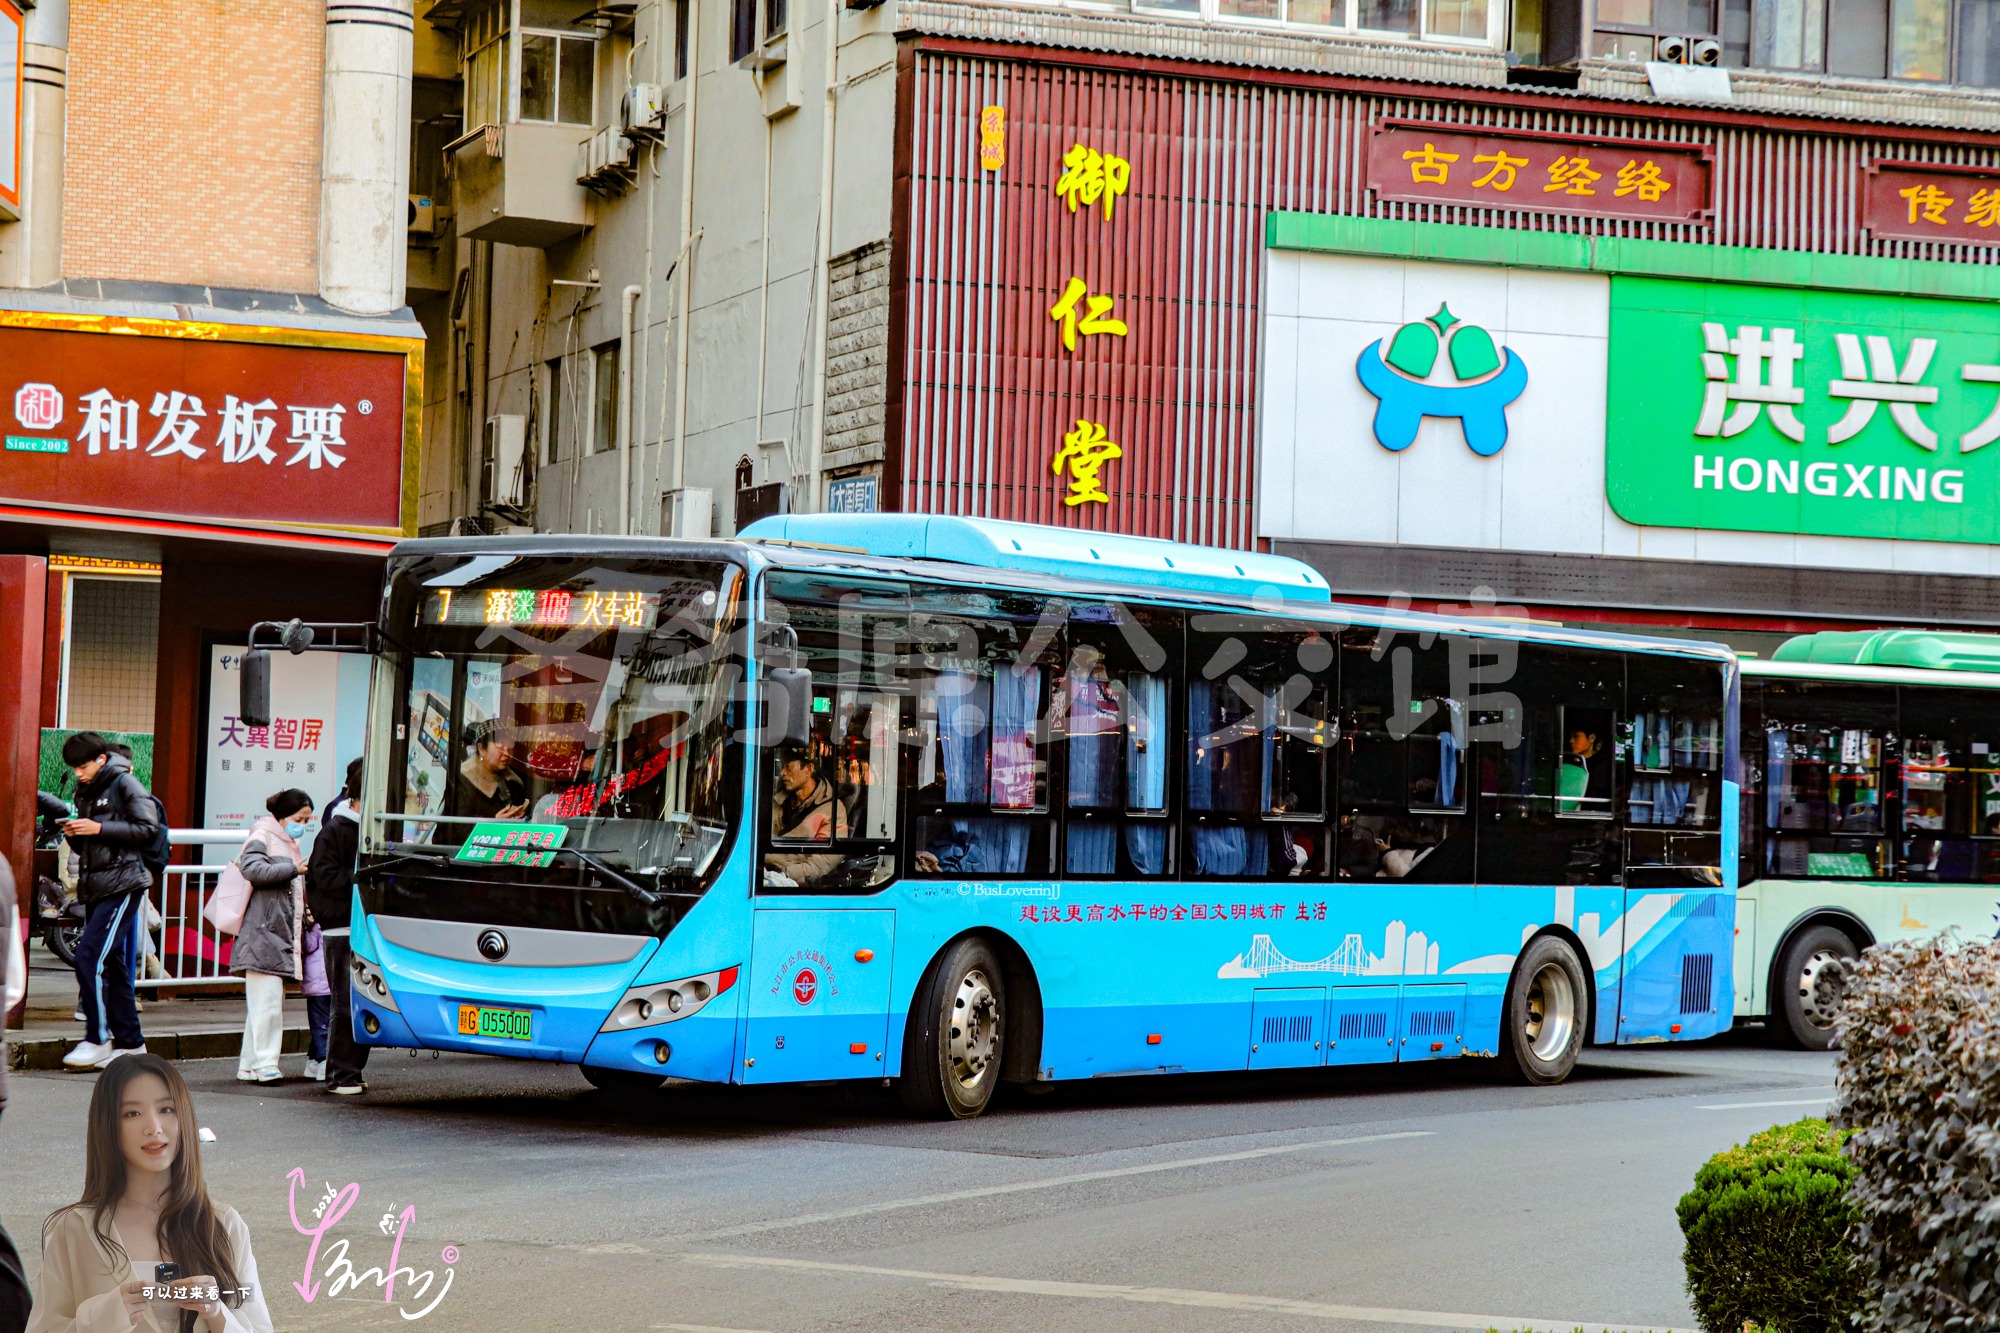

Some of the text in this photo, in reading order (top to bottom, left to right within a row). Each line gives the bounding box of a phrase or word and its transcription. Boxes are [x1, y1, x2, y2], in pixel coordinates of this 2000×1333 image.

[1402, 142, 1671, 202] 古方经络
[1050, 143, 1131, 506] 御仁堂
[6, 438, 69, 453] Since 2002
[77, 388, 347, 470] 和发板栗
[1693, 455, 1964, 504] HONGXING
[538, 591, 572, 623] 108
[581, 591, 647, 627] 火车站
[218, 716, 324, 750] 天翼智屏
[1018, 901, 1328, 923] 建设更高水平的全国文明城市 生活
